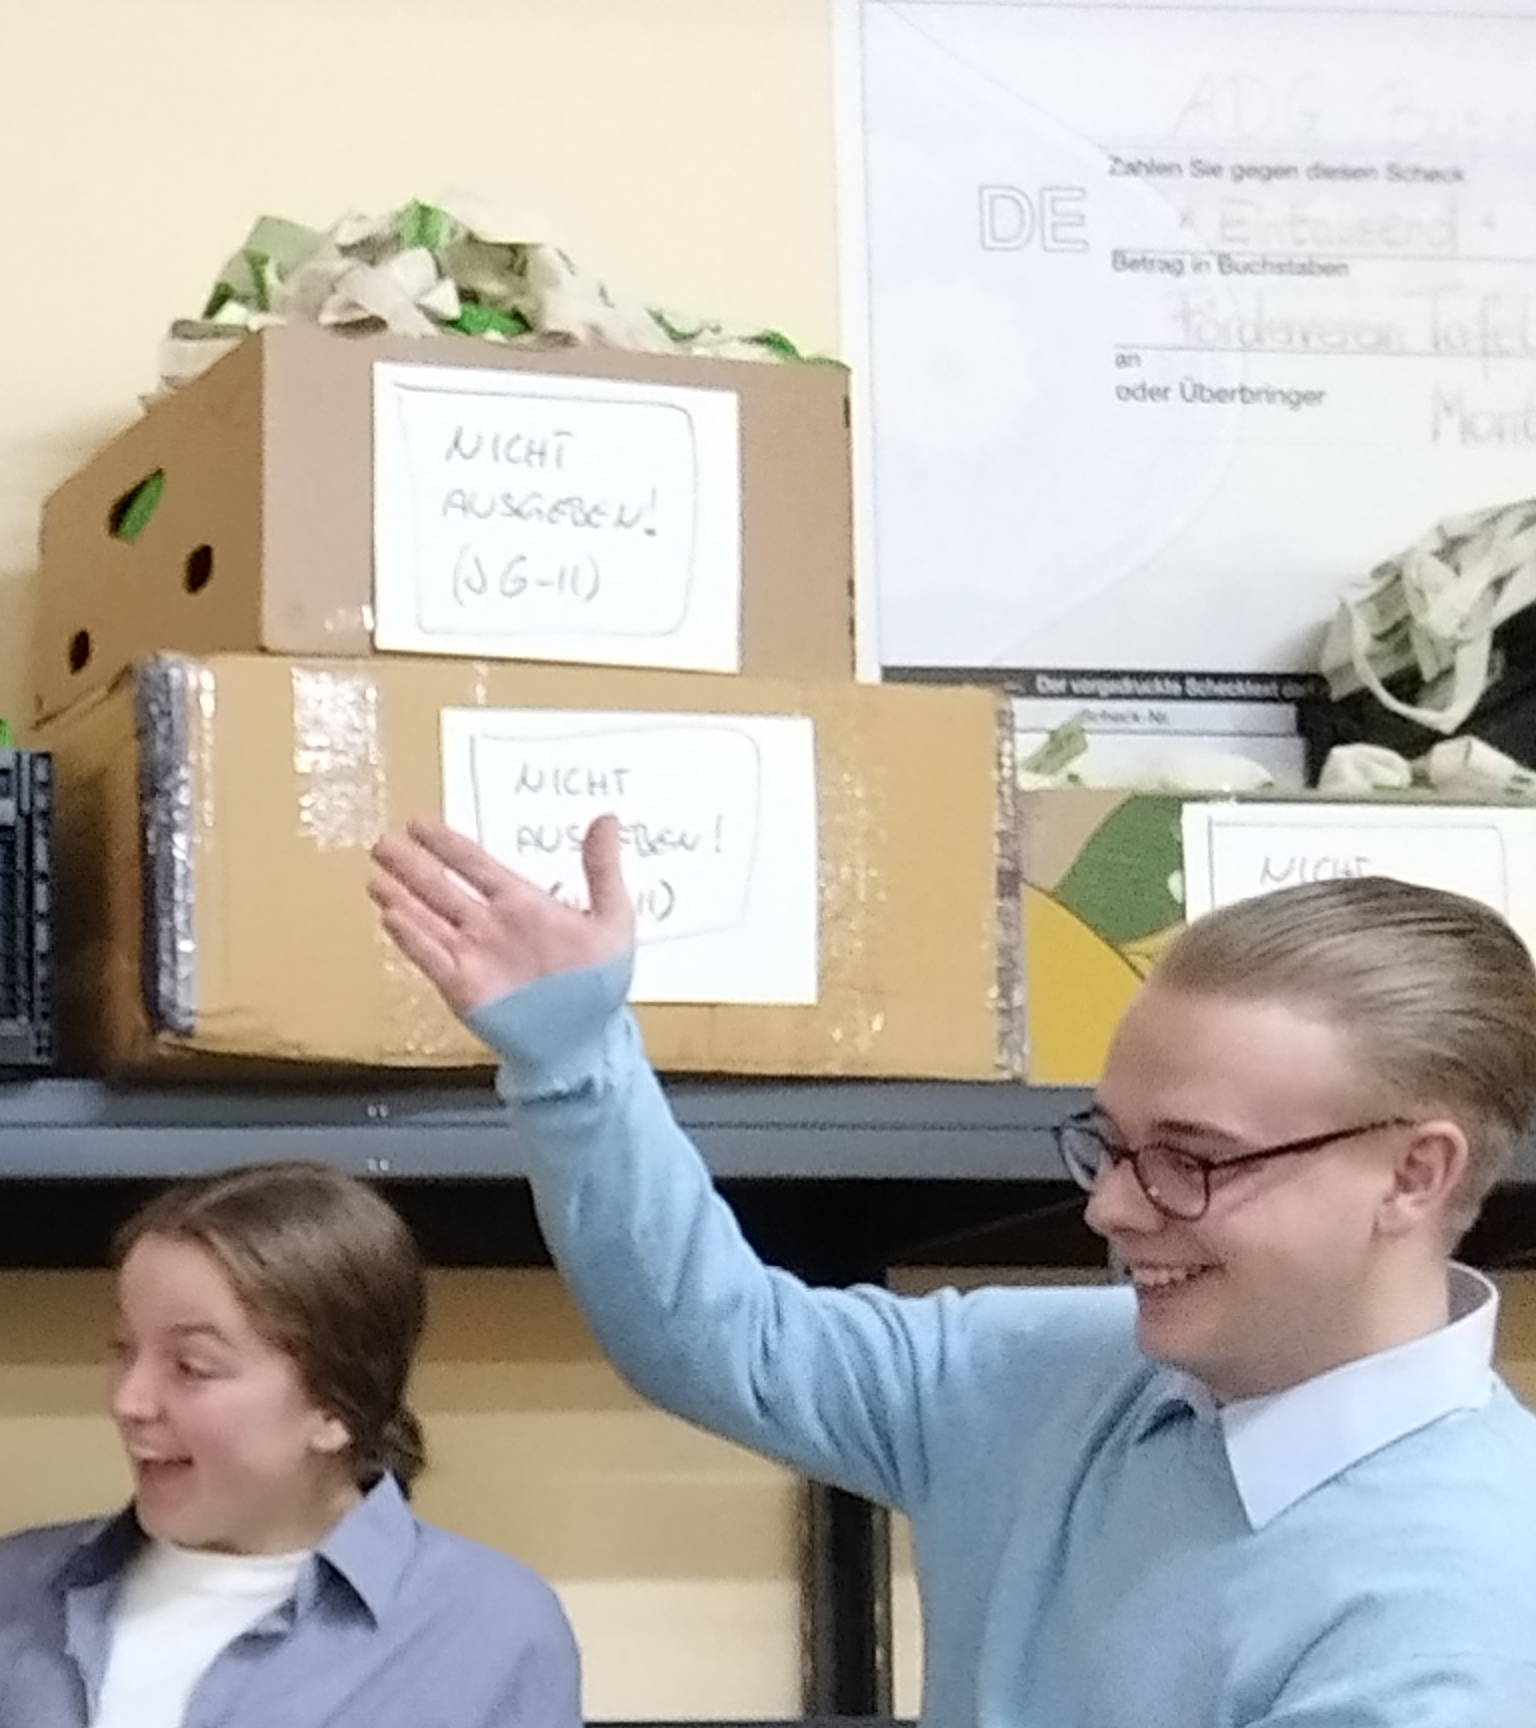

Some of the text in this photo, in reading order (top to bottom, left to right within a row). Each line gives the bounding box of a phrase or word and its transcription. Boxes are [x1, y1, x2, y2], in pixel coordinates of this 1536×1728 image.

[1109, 156, 1466, 184] Zahlen Sie gegen diesen Scheck
[977, 184, 1089, 253] DE
[1111, 250, 1350, 278] Betrag in Buchstaben
[1114, 352, 1142, 369] an
[1115, 376, 1327, 411] oder Überbringer
[445, 425, 575, 469] NICHT
[442, 486, 658, 536] AUSGEBEN!
[1035, 674, 1067, 694] Der
[514, 761, 632, 796] NICHT
